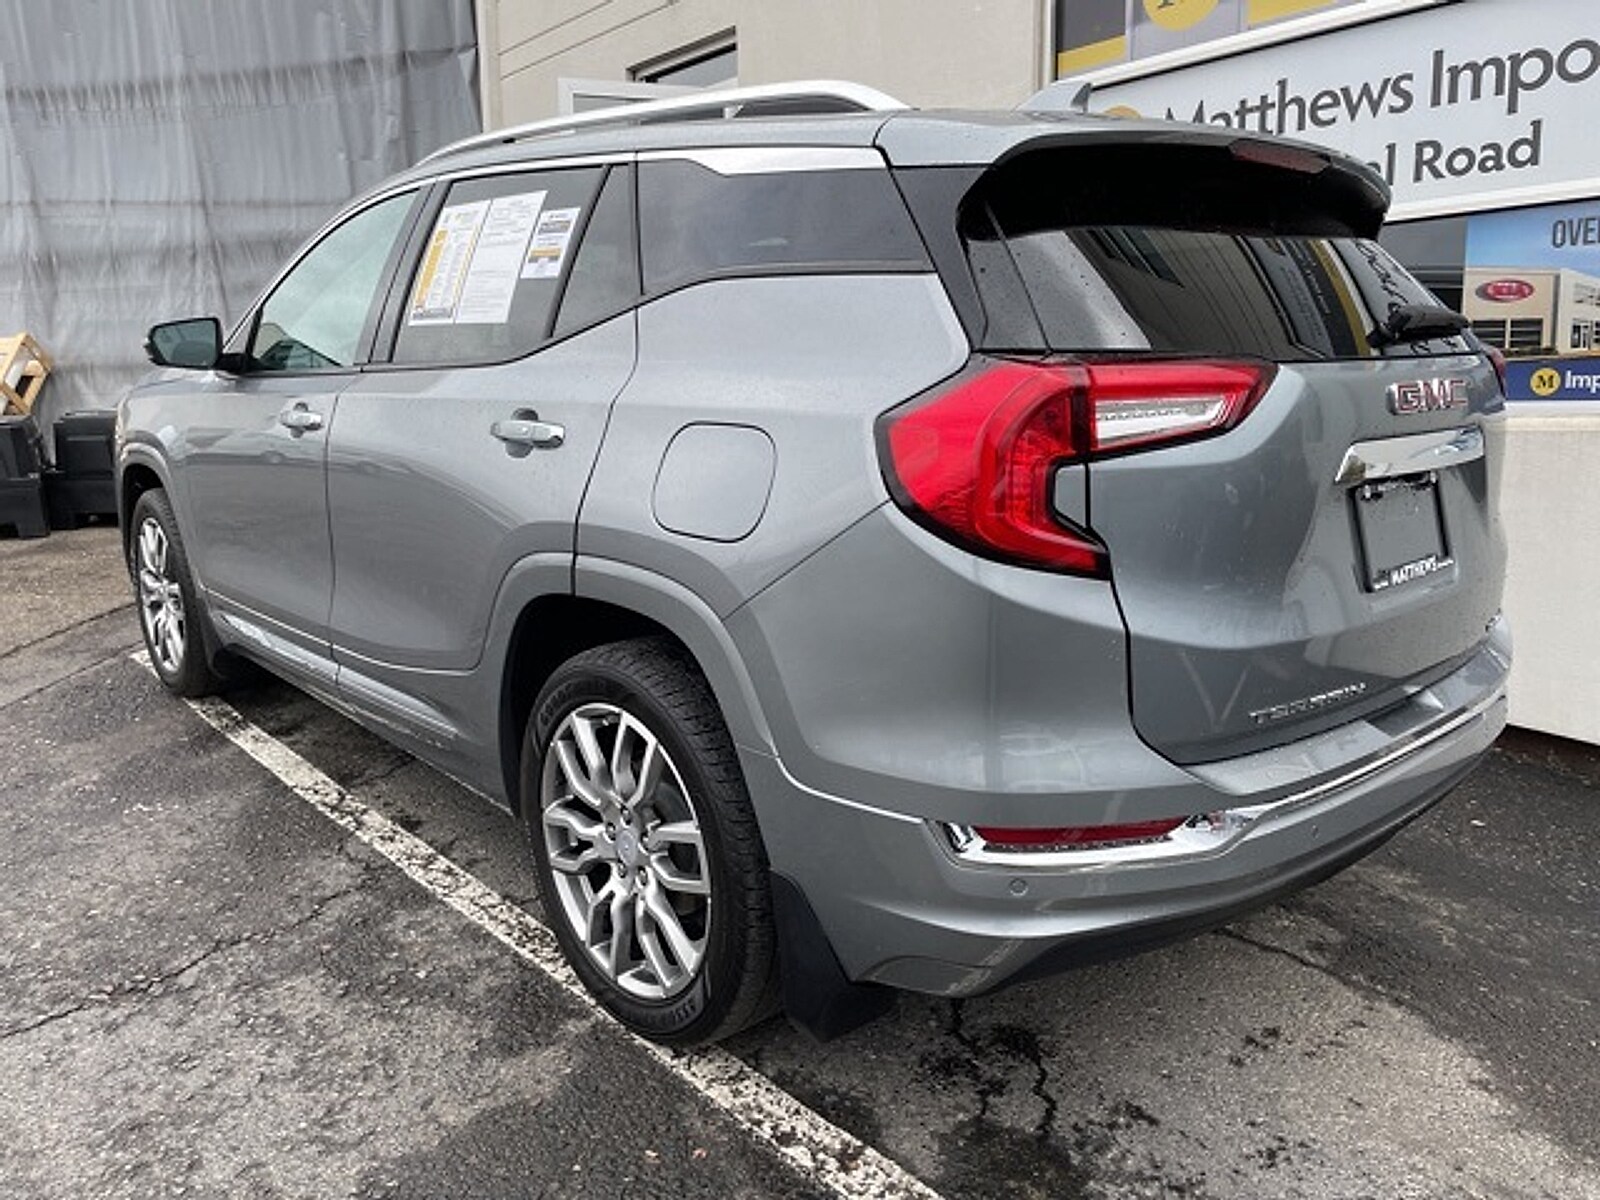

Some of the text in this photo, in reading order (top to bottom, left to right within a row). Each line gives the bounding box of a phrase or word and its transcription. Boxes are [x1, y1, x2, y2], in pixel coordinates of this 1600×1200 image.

[1430, 39, 1600, 115] Impo
[1412, 118, 1542, 183] Road
[1552, 217, 1600, 249] OVE
[1396, 379, 1468, 413] GMC
